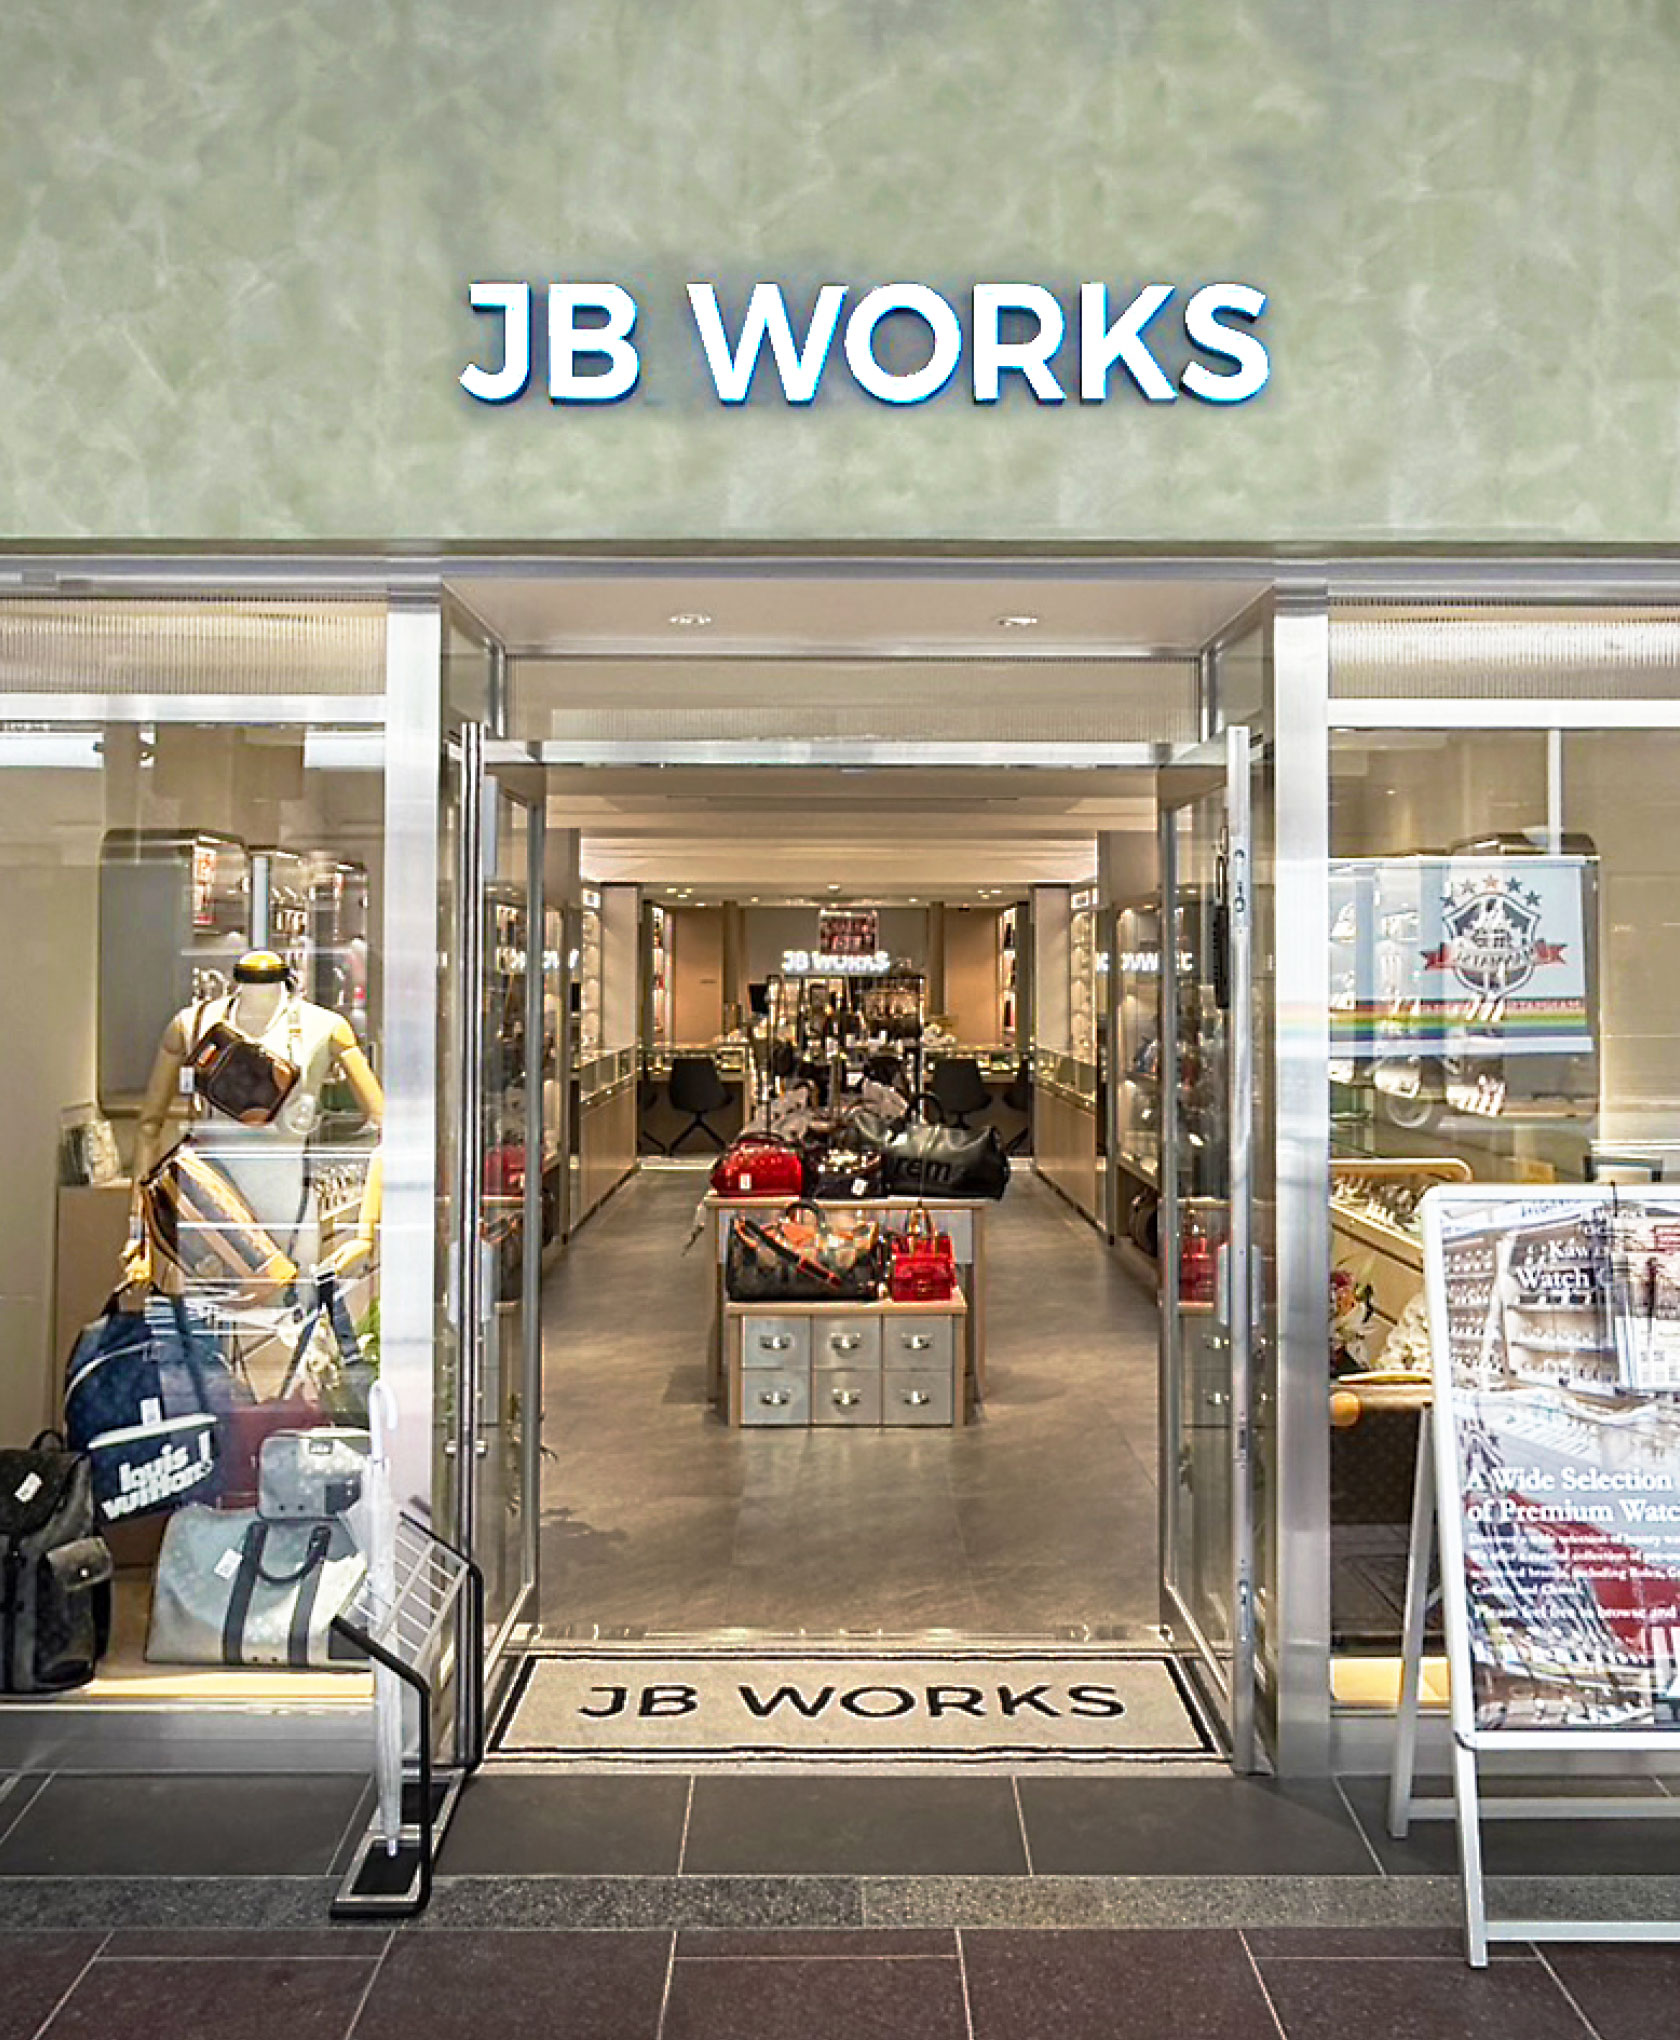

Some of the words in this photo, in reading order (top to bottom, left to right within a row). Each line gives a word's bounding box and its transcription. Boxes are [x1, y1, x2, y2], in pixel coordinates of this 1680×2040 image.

[458, 281, 641, 405] JB
[685, 281, 1271, 405] WORKS
[1516, 1266, 1590, 1289] Watch
[1466, 1467, 1484, 1490] A
[1489, 1467, 1555, 1490] Wide
[1561, 1467, 1674, 1490] Selection
[1467, 1499, 1495, 1522] of
[1500, 1499, 1614, 1522] Premium
[577, 1684, 700, 1718] JB
[738, 1684, 1126, 1718] WORKS
